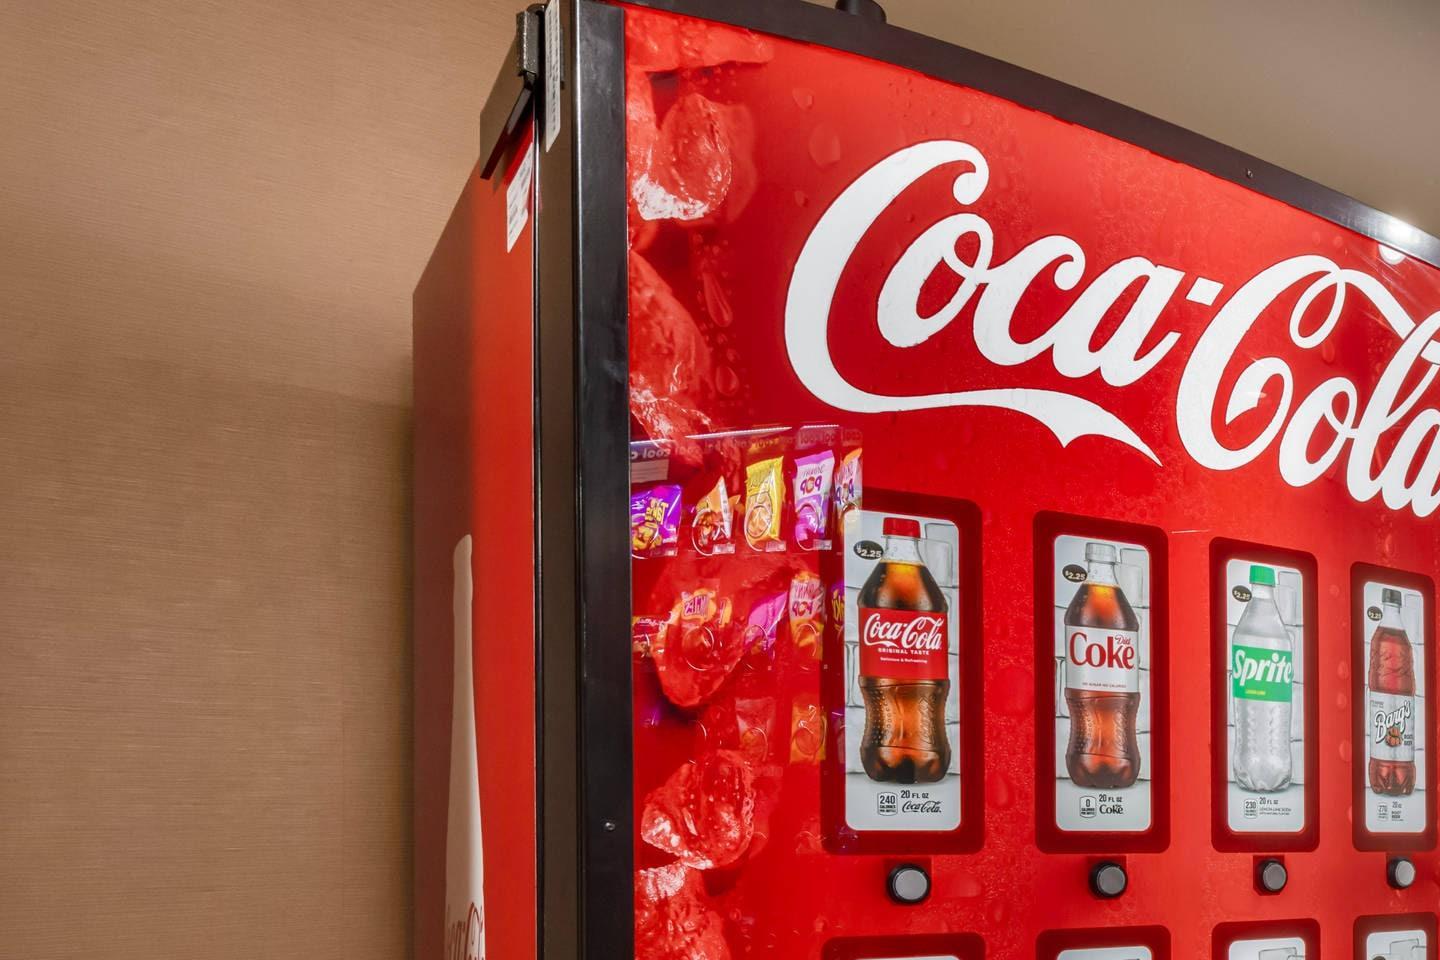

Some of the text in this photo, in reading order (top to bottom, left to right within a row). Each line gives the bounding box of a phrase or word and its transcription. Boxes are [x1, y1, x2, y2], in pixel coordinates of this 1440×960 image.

[1065, 570, 1086, 580] $2.25
[863, 613, 944, 650] Coca-Cola
[1069, 631, 1135, 670] Coke
[1232, 649, 1292, 687] Sprite
[1375, 700, 1411, 744] Barq's
[900, 789, 910, 799] 20
[1098, 793, 1107, 803] 20
[879, 795, 896, 805] 240
[1085, 798, 1091, 808] 0
[902, 800, 943, 813] Coca-Cola
[1099, 804, 1124, 814] Coke
